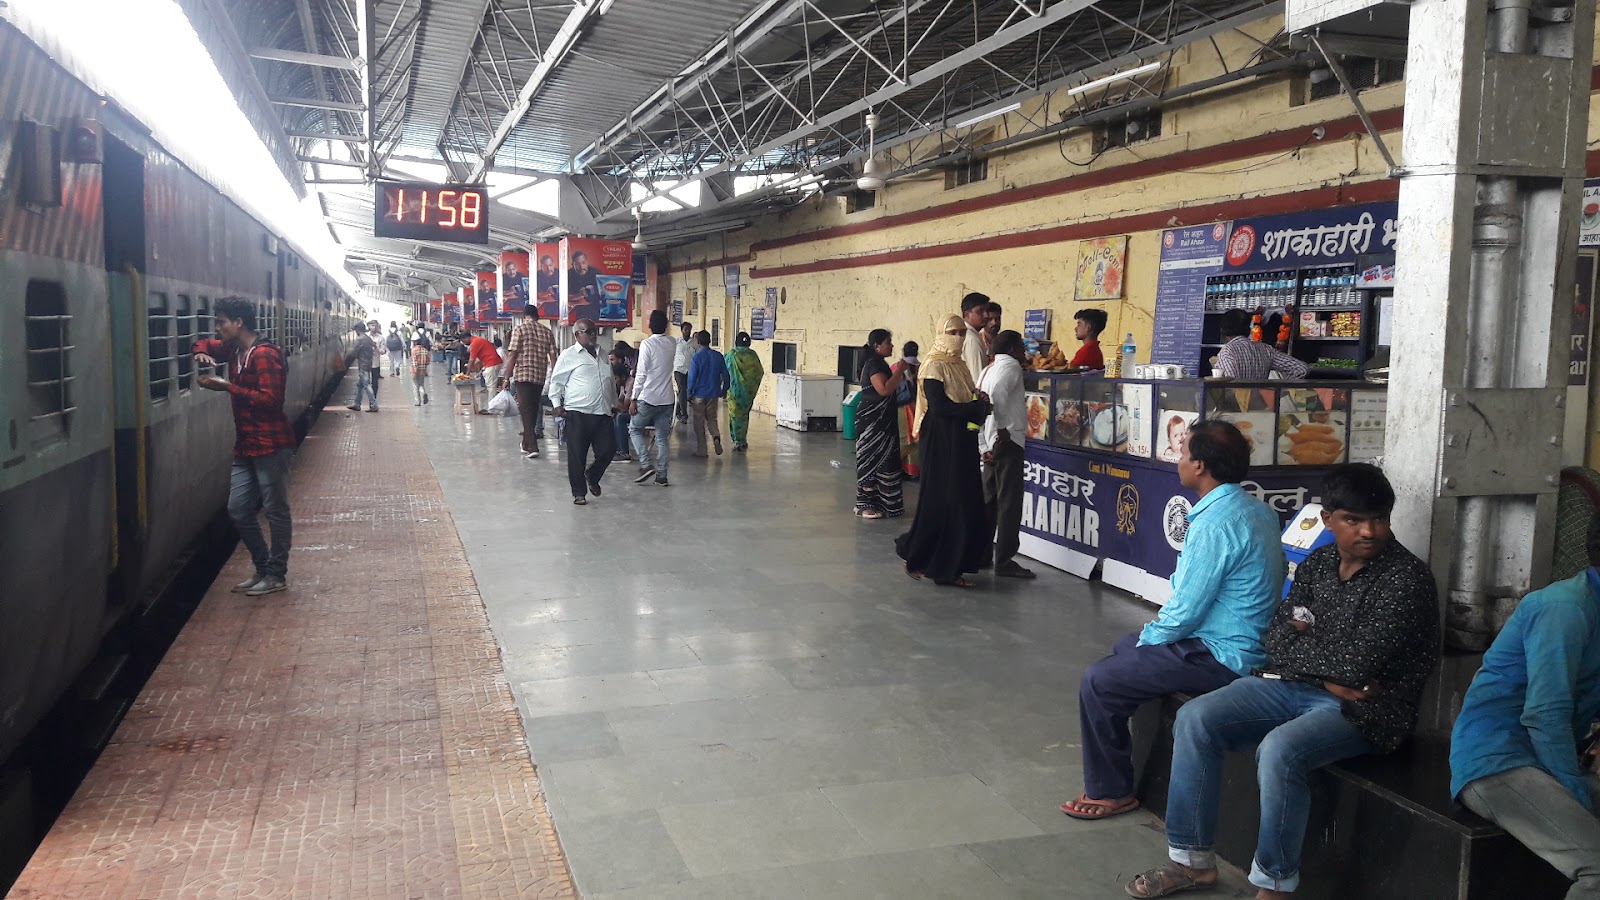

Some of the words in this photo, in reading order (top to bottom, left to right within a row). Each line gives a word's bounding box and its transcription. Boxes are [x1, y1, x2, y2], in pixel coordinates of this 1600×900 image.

[1261, 211, 1376, 262] शाकाहारी
[1569, 360, 1586, 375] ar
[1022, 459, 1096, 506] आहार
[1020, 491, 1100, 548] AAHAR
